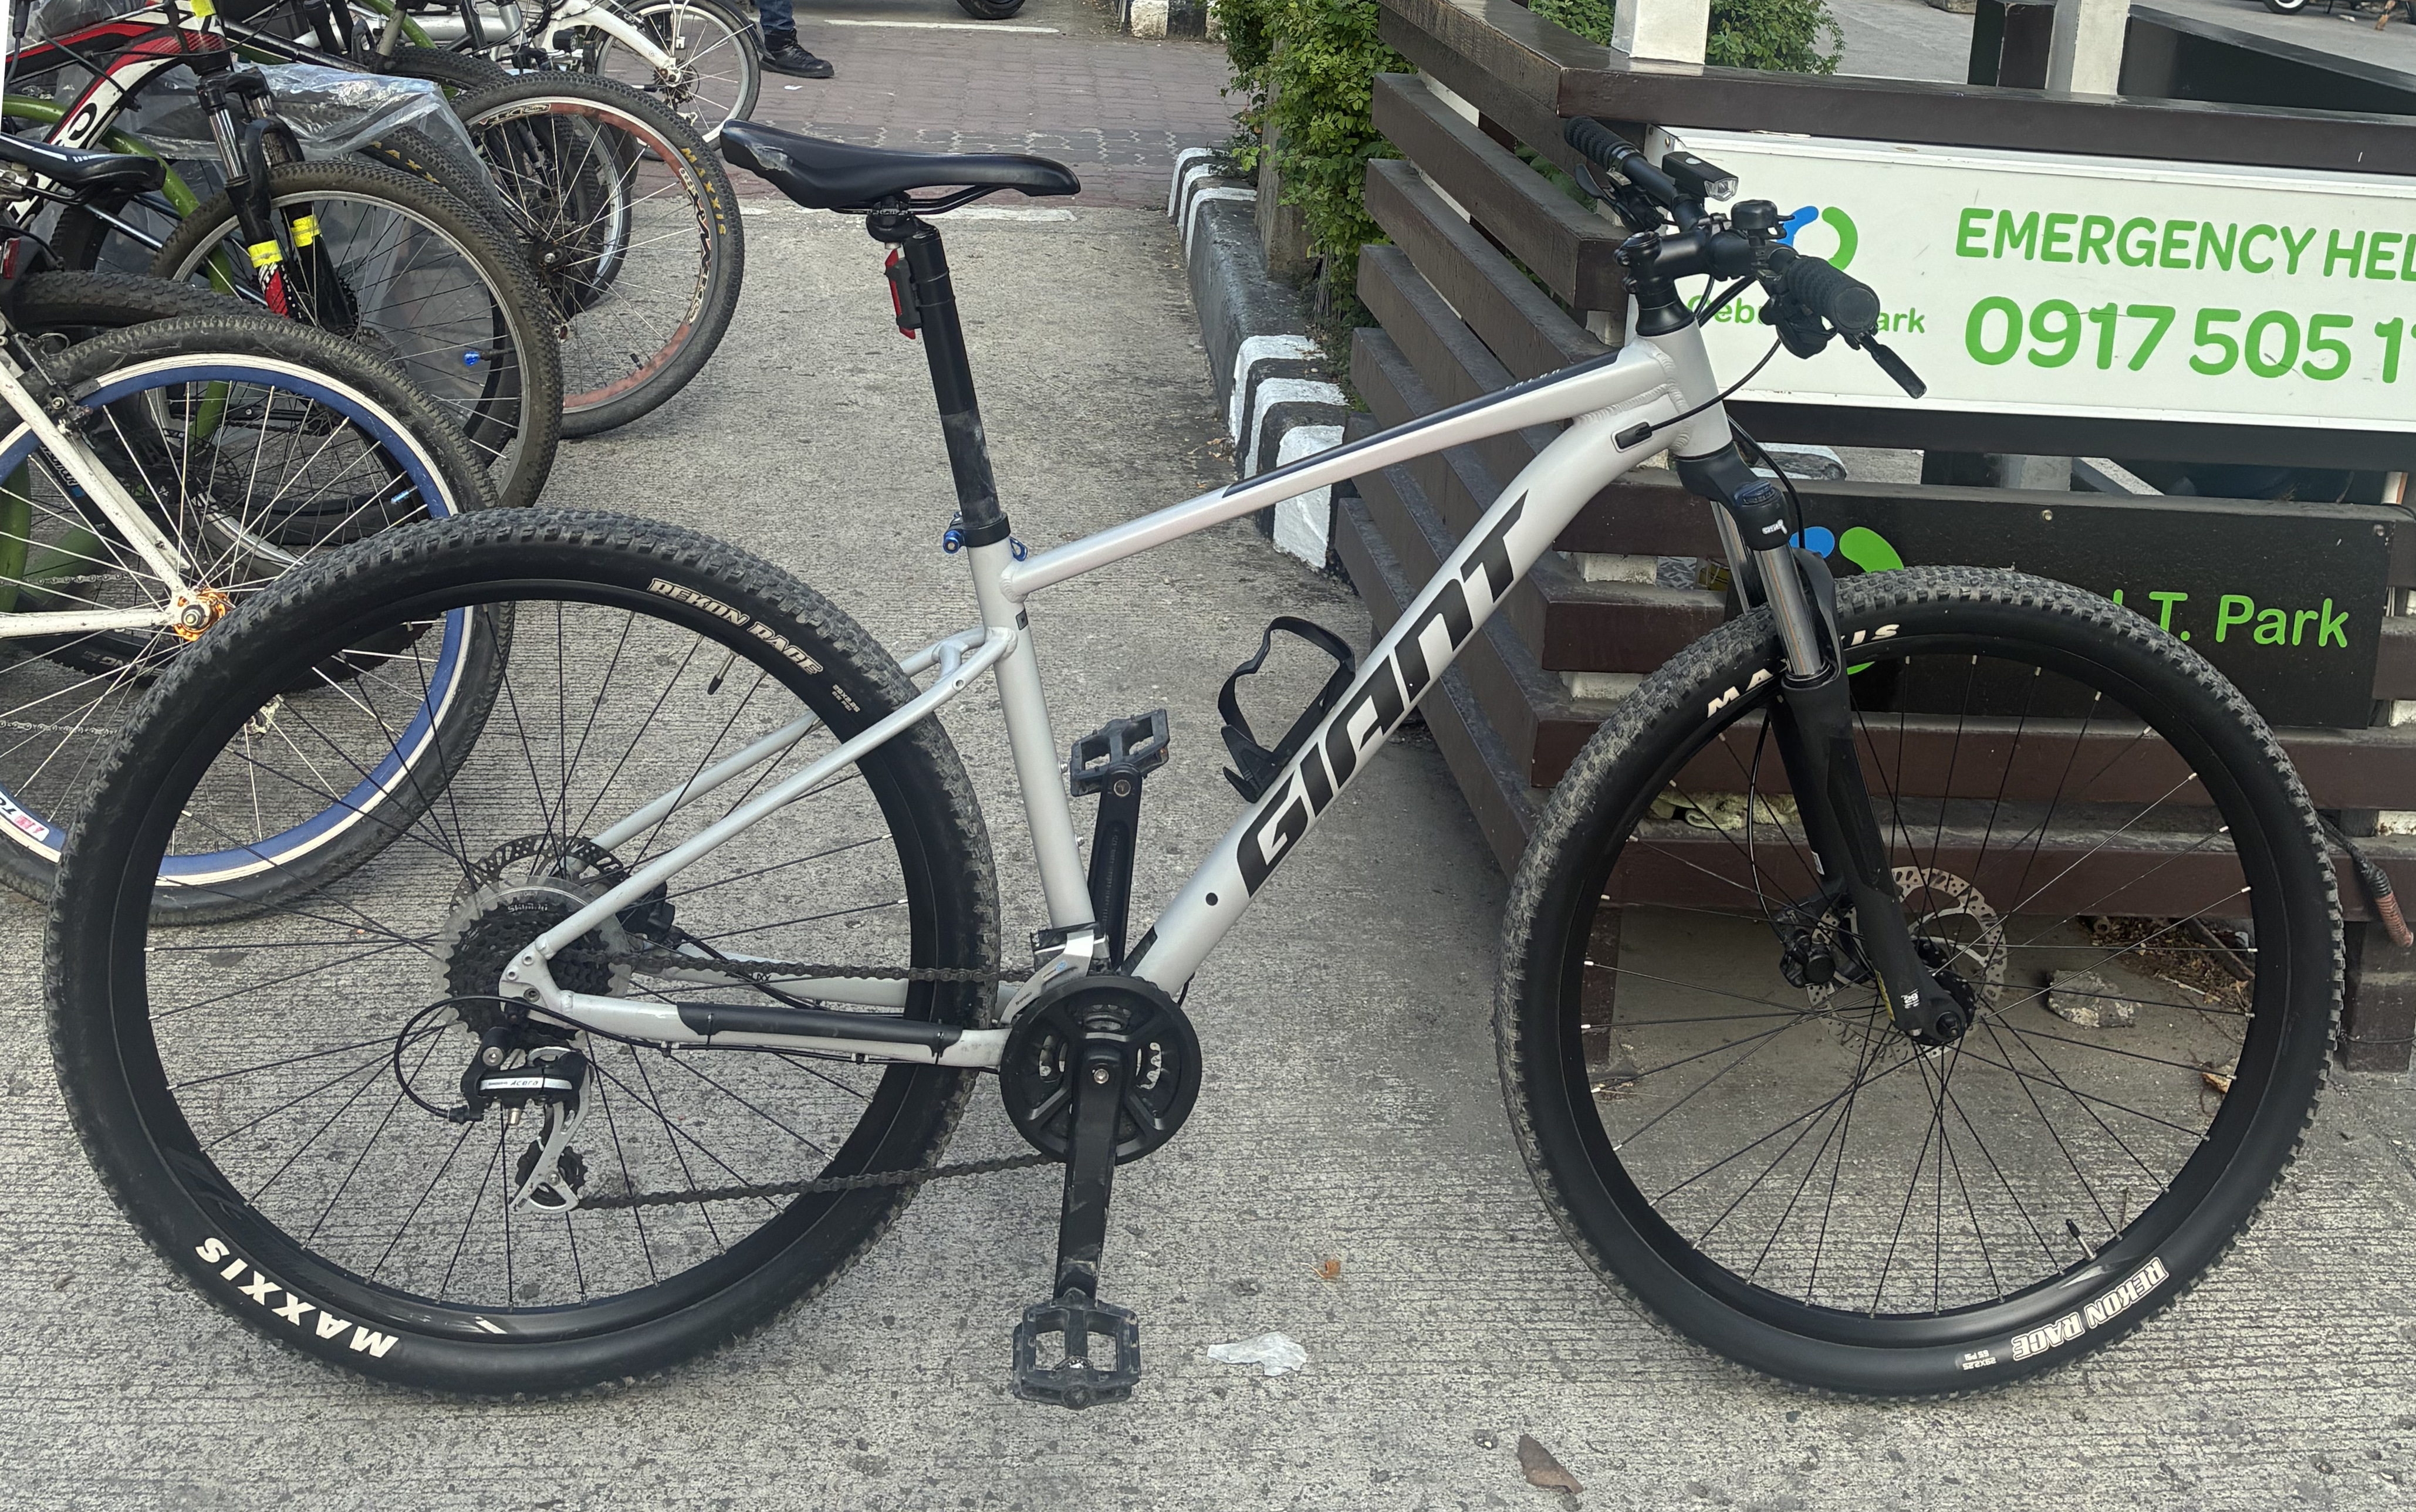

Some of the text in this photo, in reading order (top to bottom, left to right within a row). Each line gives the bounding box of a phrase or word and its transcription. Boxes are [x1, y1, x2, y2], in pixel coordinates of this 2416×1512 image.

[681, 147, 727, 235] MAXXIS
[1955, 207, 2316, 275] EMERGENCY
[1877, 307, 1925, 334] ark
[1965, 296, 2416, 384] 0917 505 1
[648, 578, 824, 675] REKON RACE
[2215, 594, 2349, 648] Park
[1236, 488, 1529, 898] GIANT
[1708, 624, 1900, 718] MAIS
[195, 1237, 399, 1358] MAXXIS
[2011, 1257, 2170, 1361] REKON RACE
